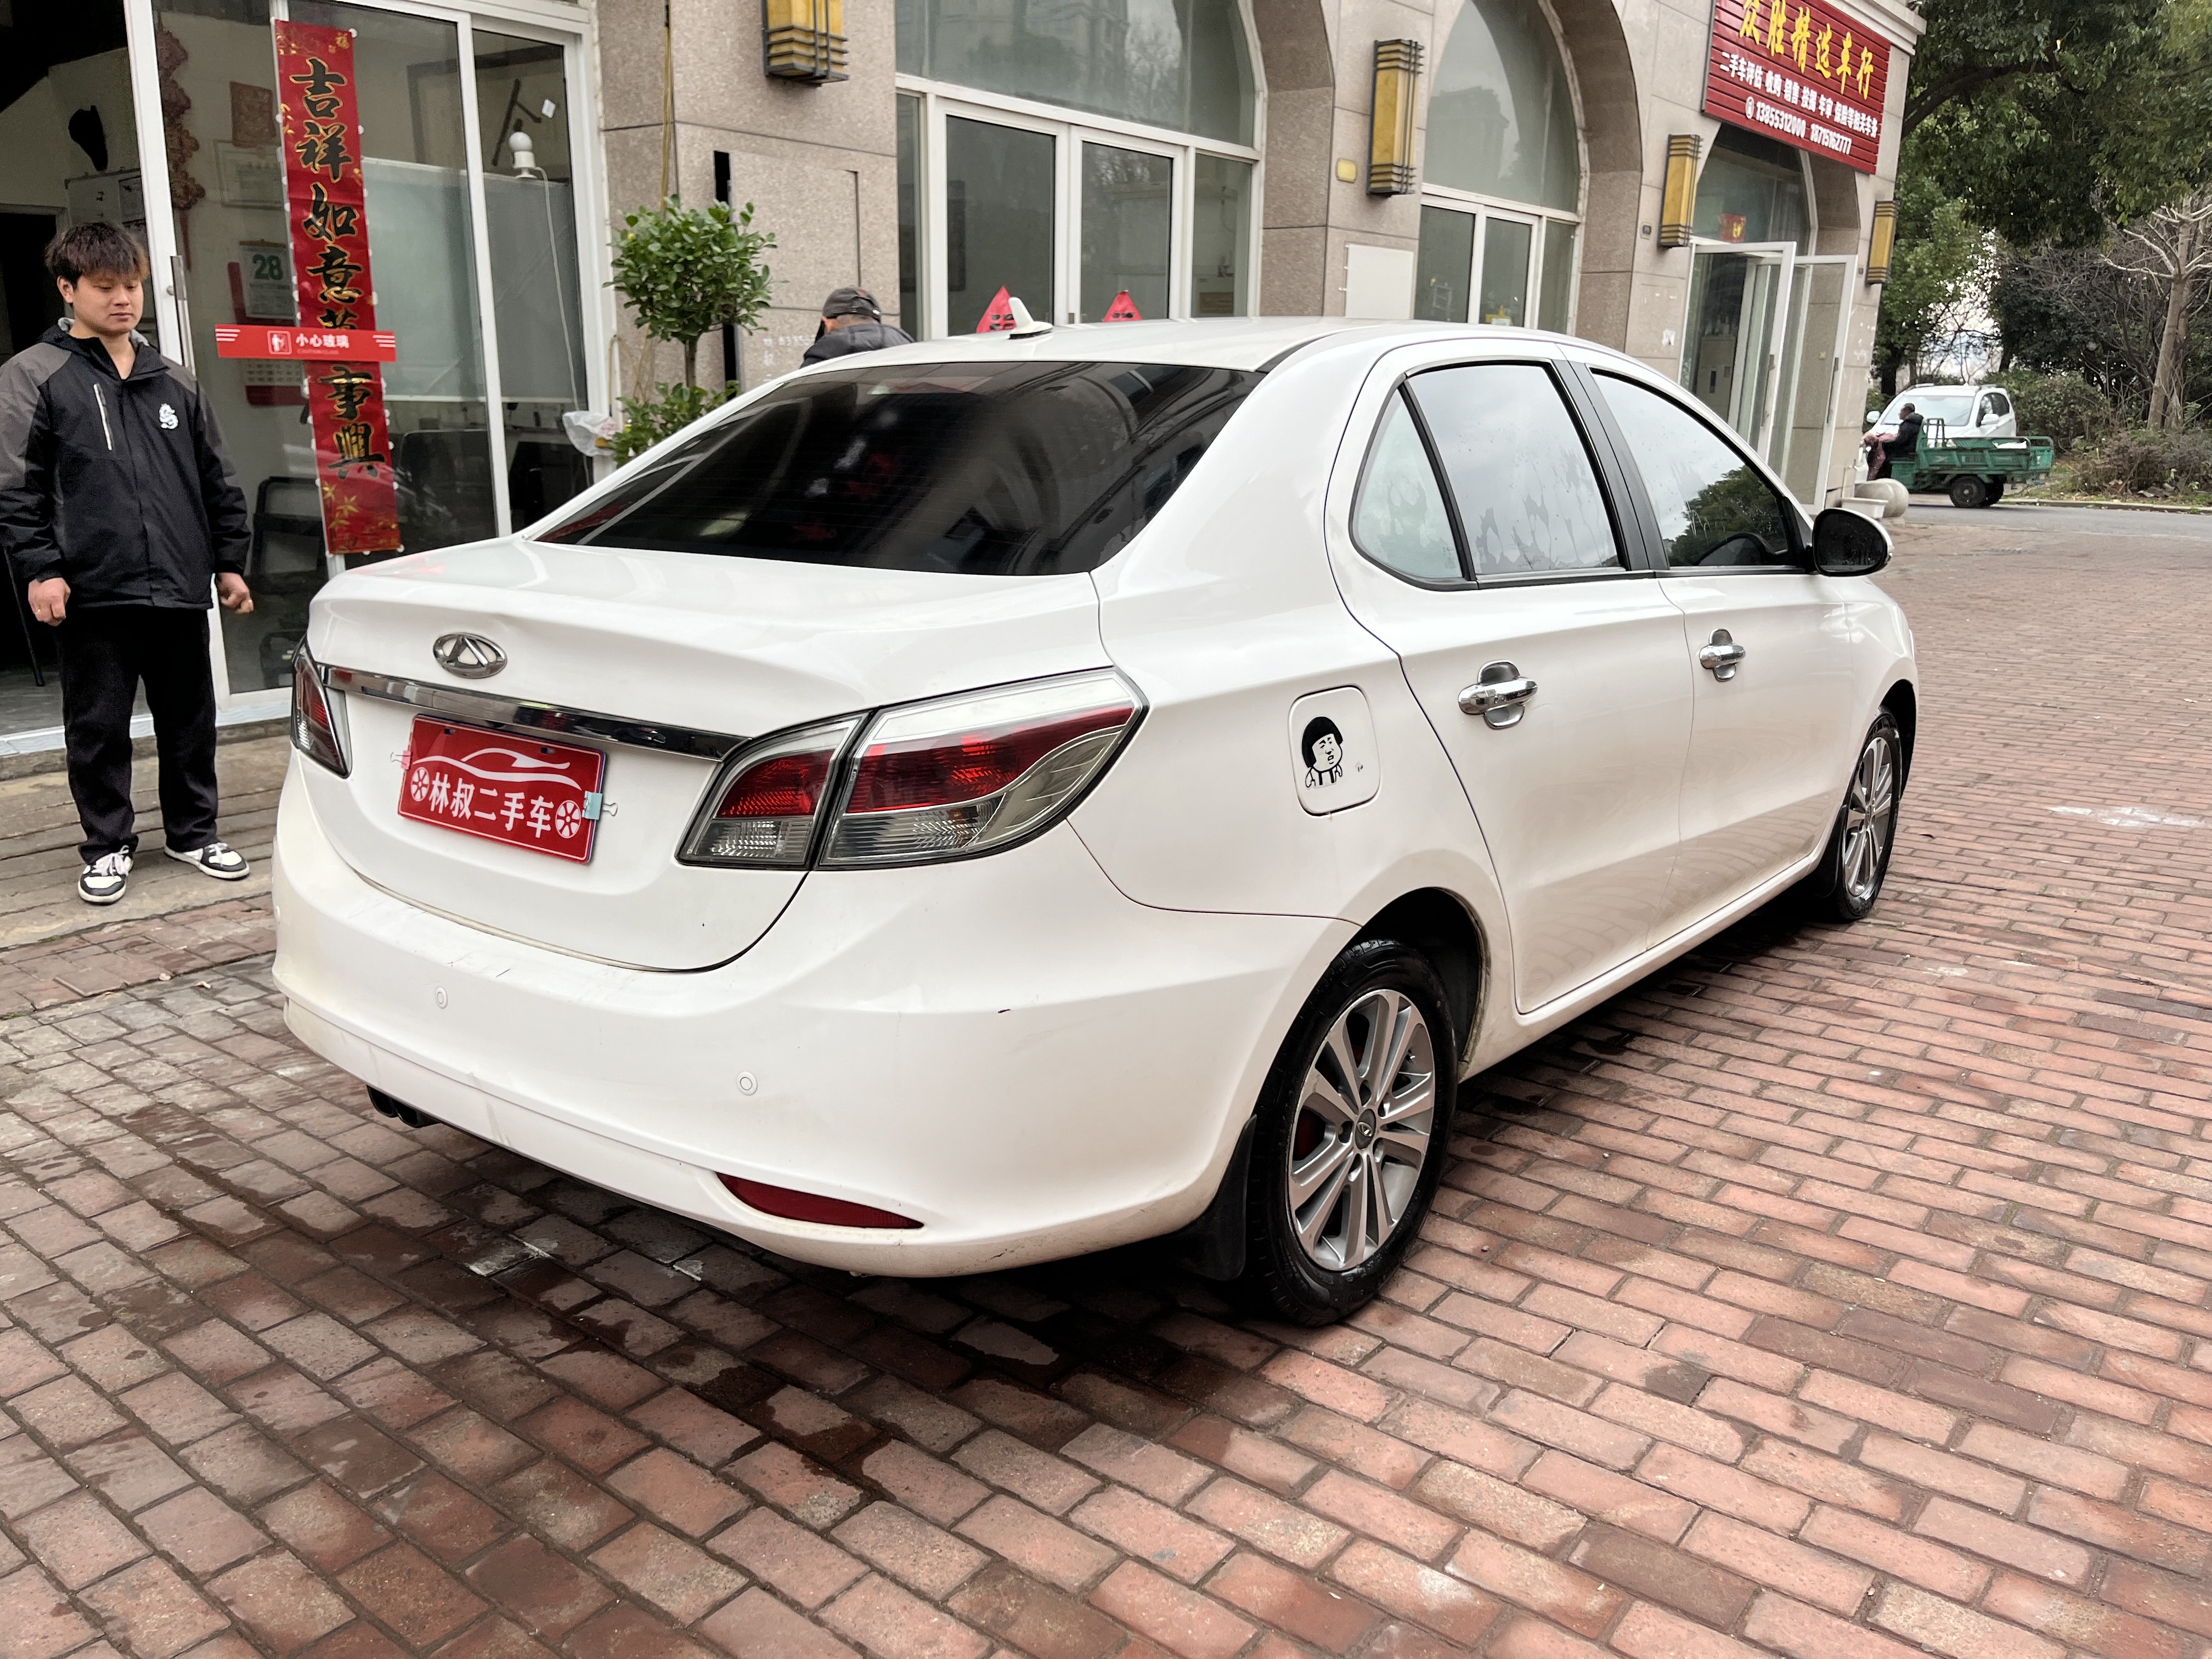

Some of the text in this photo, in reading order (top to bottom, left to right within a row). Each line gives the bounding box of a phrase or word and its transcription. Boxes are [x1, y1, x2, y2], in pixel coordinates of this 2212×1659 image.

[1720, 52, 1763, 89] 二手车评估
[1765, 70, 1782, 97] 收购
[1784, 78, 1800, 105] 销售
[1801, 86, 1818, 112] 按揭
[1818, 94, 1833, 119] 年审
[1756, 101, 1852, 155] 13855312000 18715162777
[252, 254, 284, 280] 28
[296, 333, 349, 348] 小心玻璃
[428, 771, 555, 838] 林叔二手车
